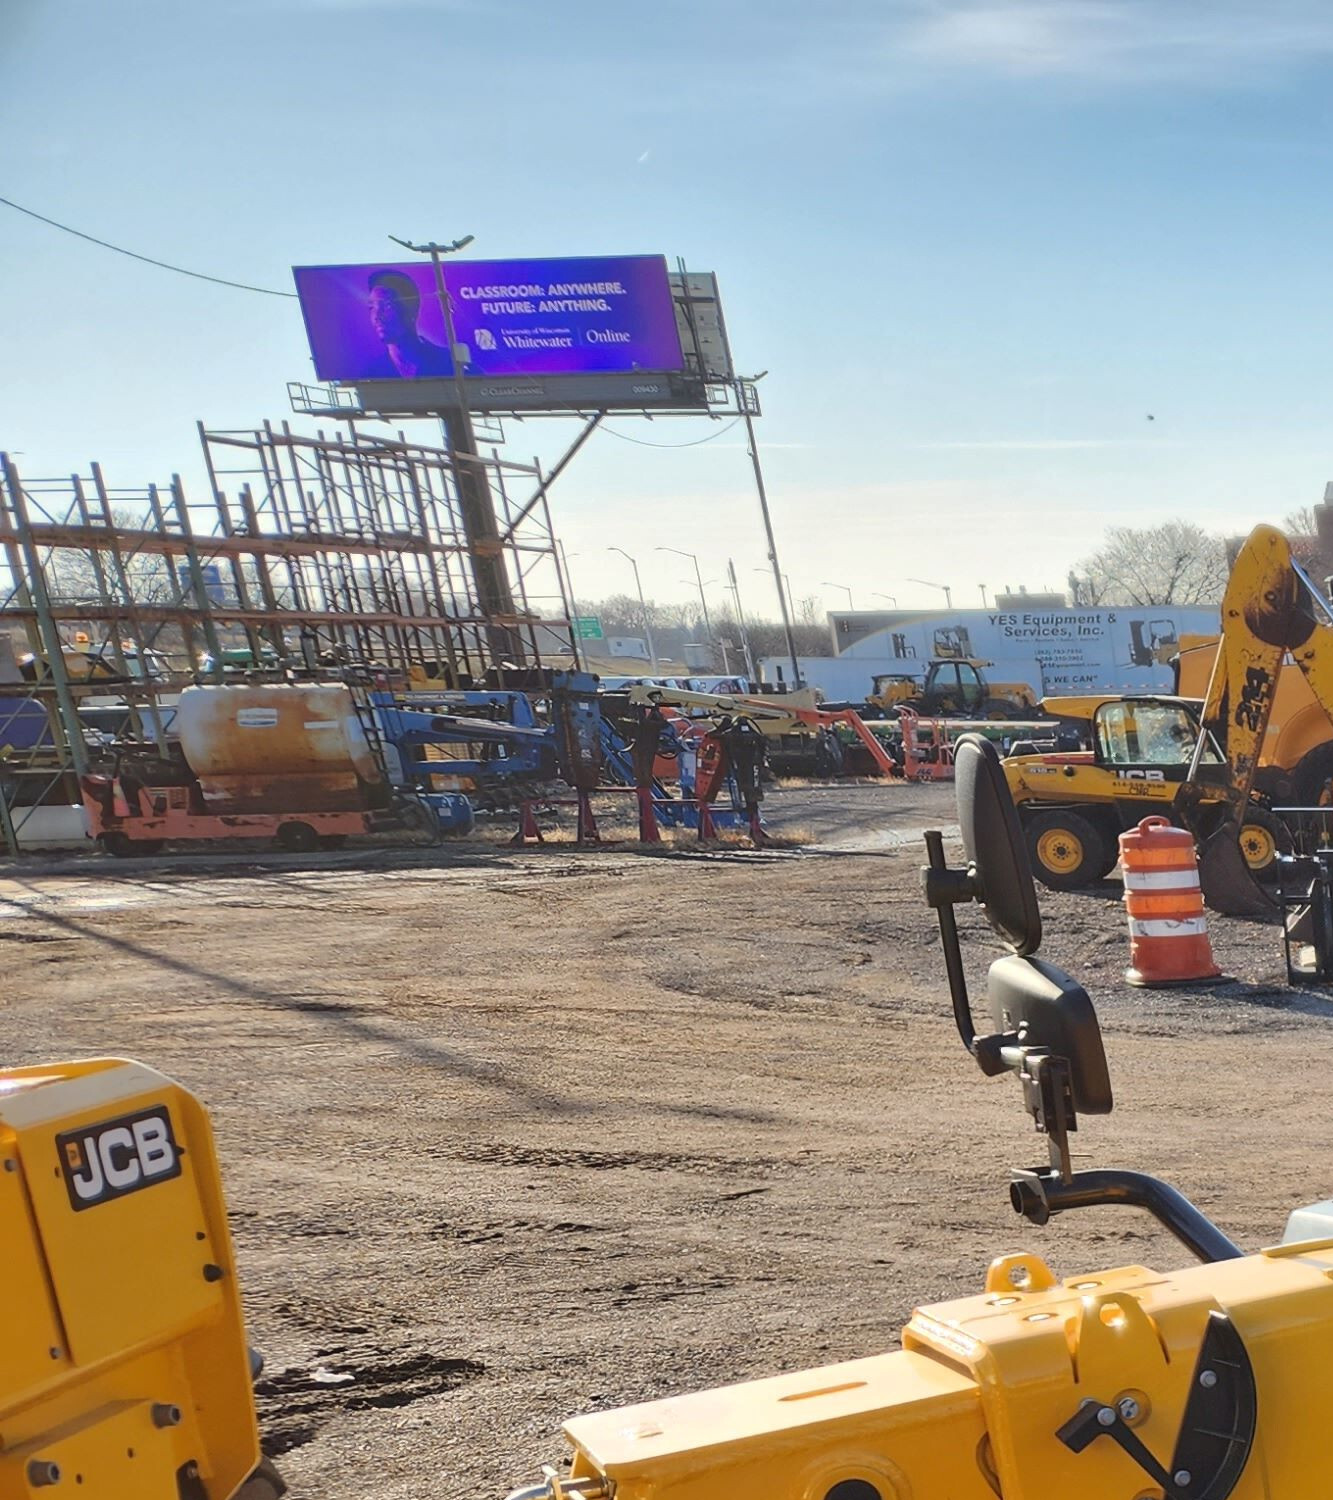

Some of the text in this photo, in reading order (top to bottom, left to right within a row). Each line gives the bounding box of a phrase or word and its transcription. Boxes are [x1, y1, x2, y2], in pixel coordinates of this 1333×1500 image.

[460, 282, 627, 299] CLASSROOM: ANYWHERE.
[481, 299, 612, 315] FUTURE: ANYTHING.
[502, 336, 573, 349] Whitewater
[585, 328, 631, 344] Online
[988, 612, 1117, 627] YES Equipment &
[1004, 625, 1105, 637] Services, Inc.
[1054, 675, 1071, 683] WE
[73, 1116, 175, 1199] JCB
